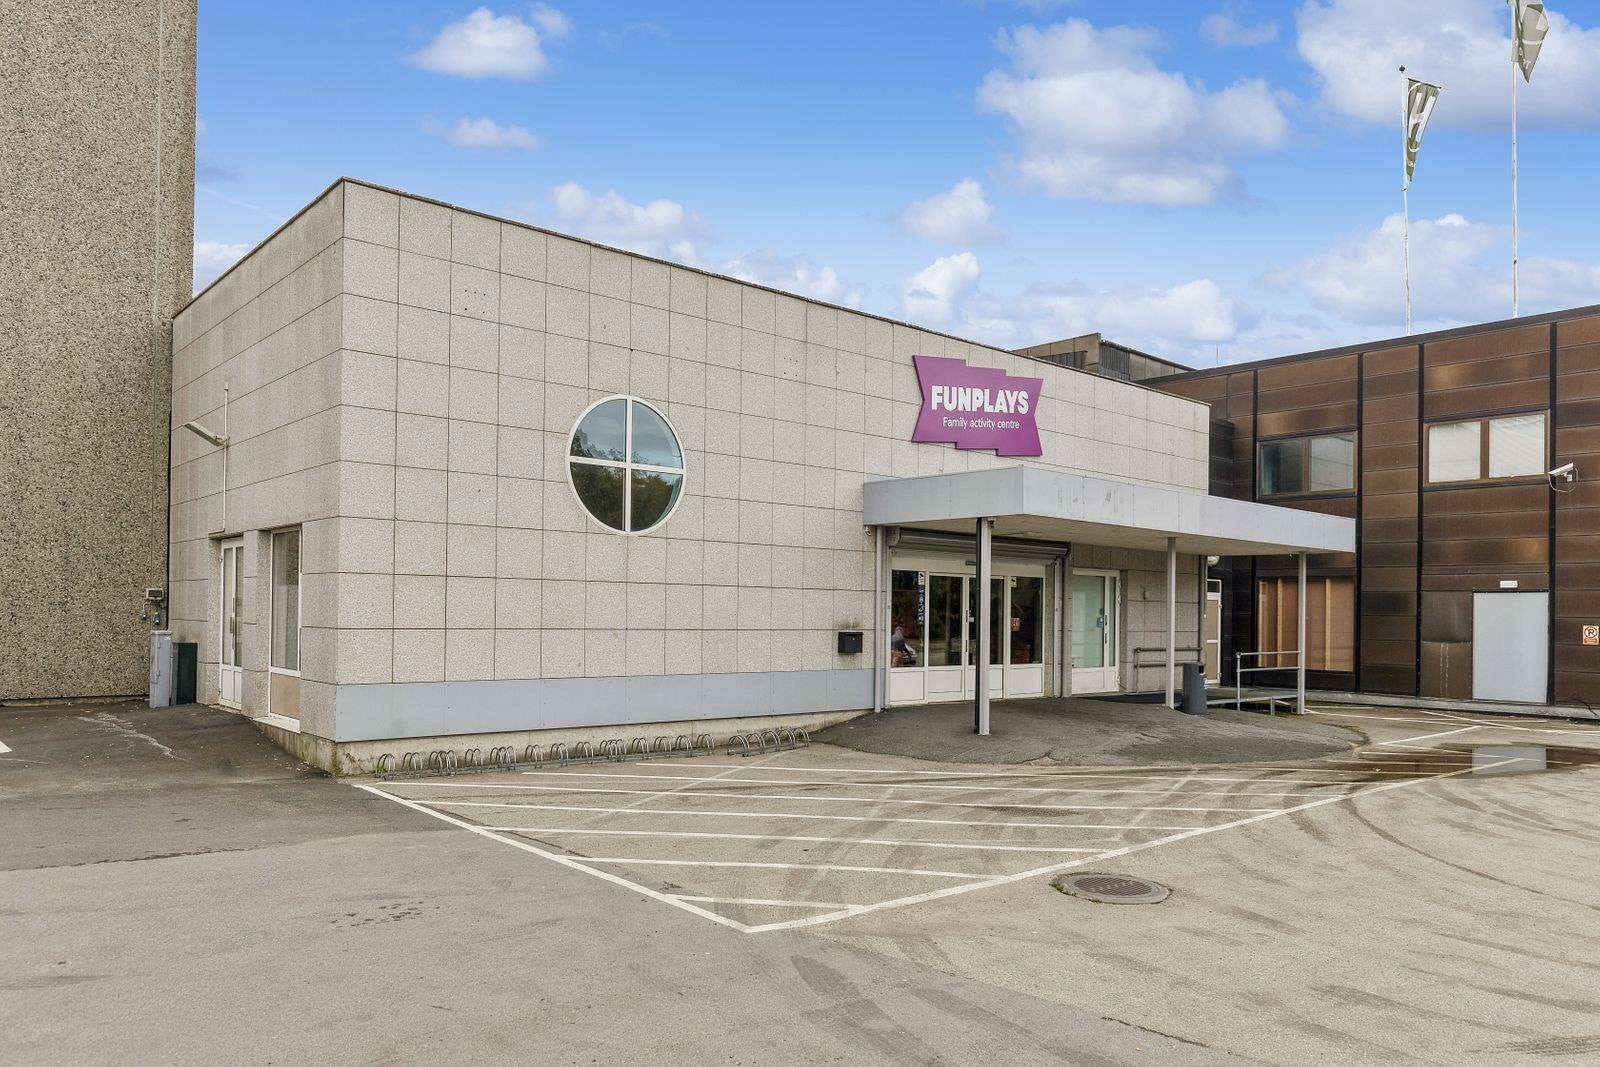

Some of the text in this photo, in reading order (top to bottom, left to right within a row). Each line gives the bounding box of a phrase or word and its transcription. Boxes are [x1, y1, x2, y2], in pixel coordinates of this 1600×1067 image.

[931, 385, 1029, 414] FUNPLAYS
[943, 416, 1020, 430] Family activity centre
